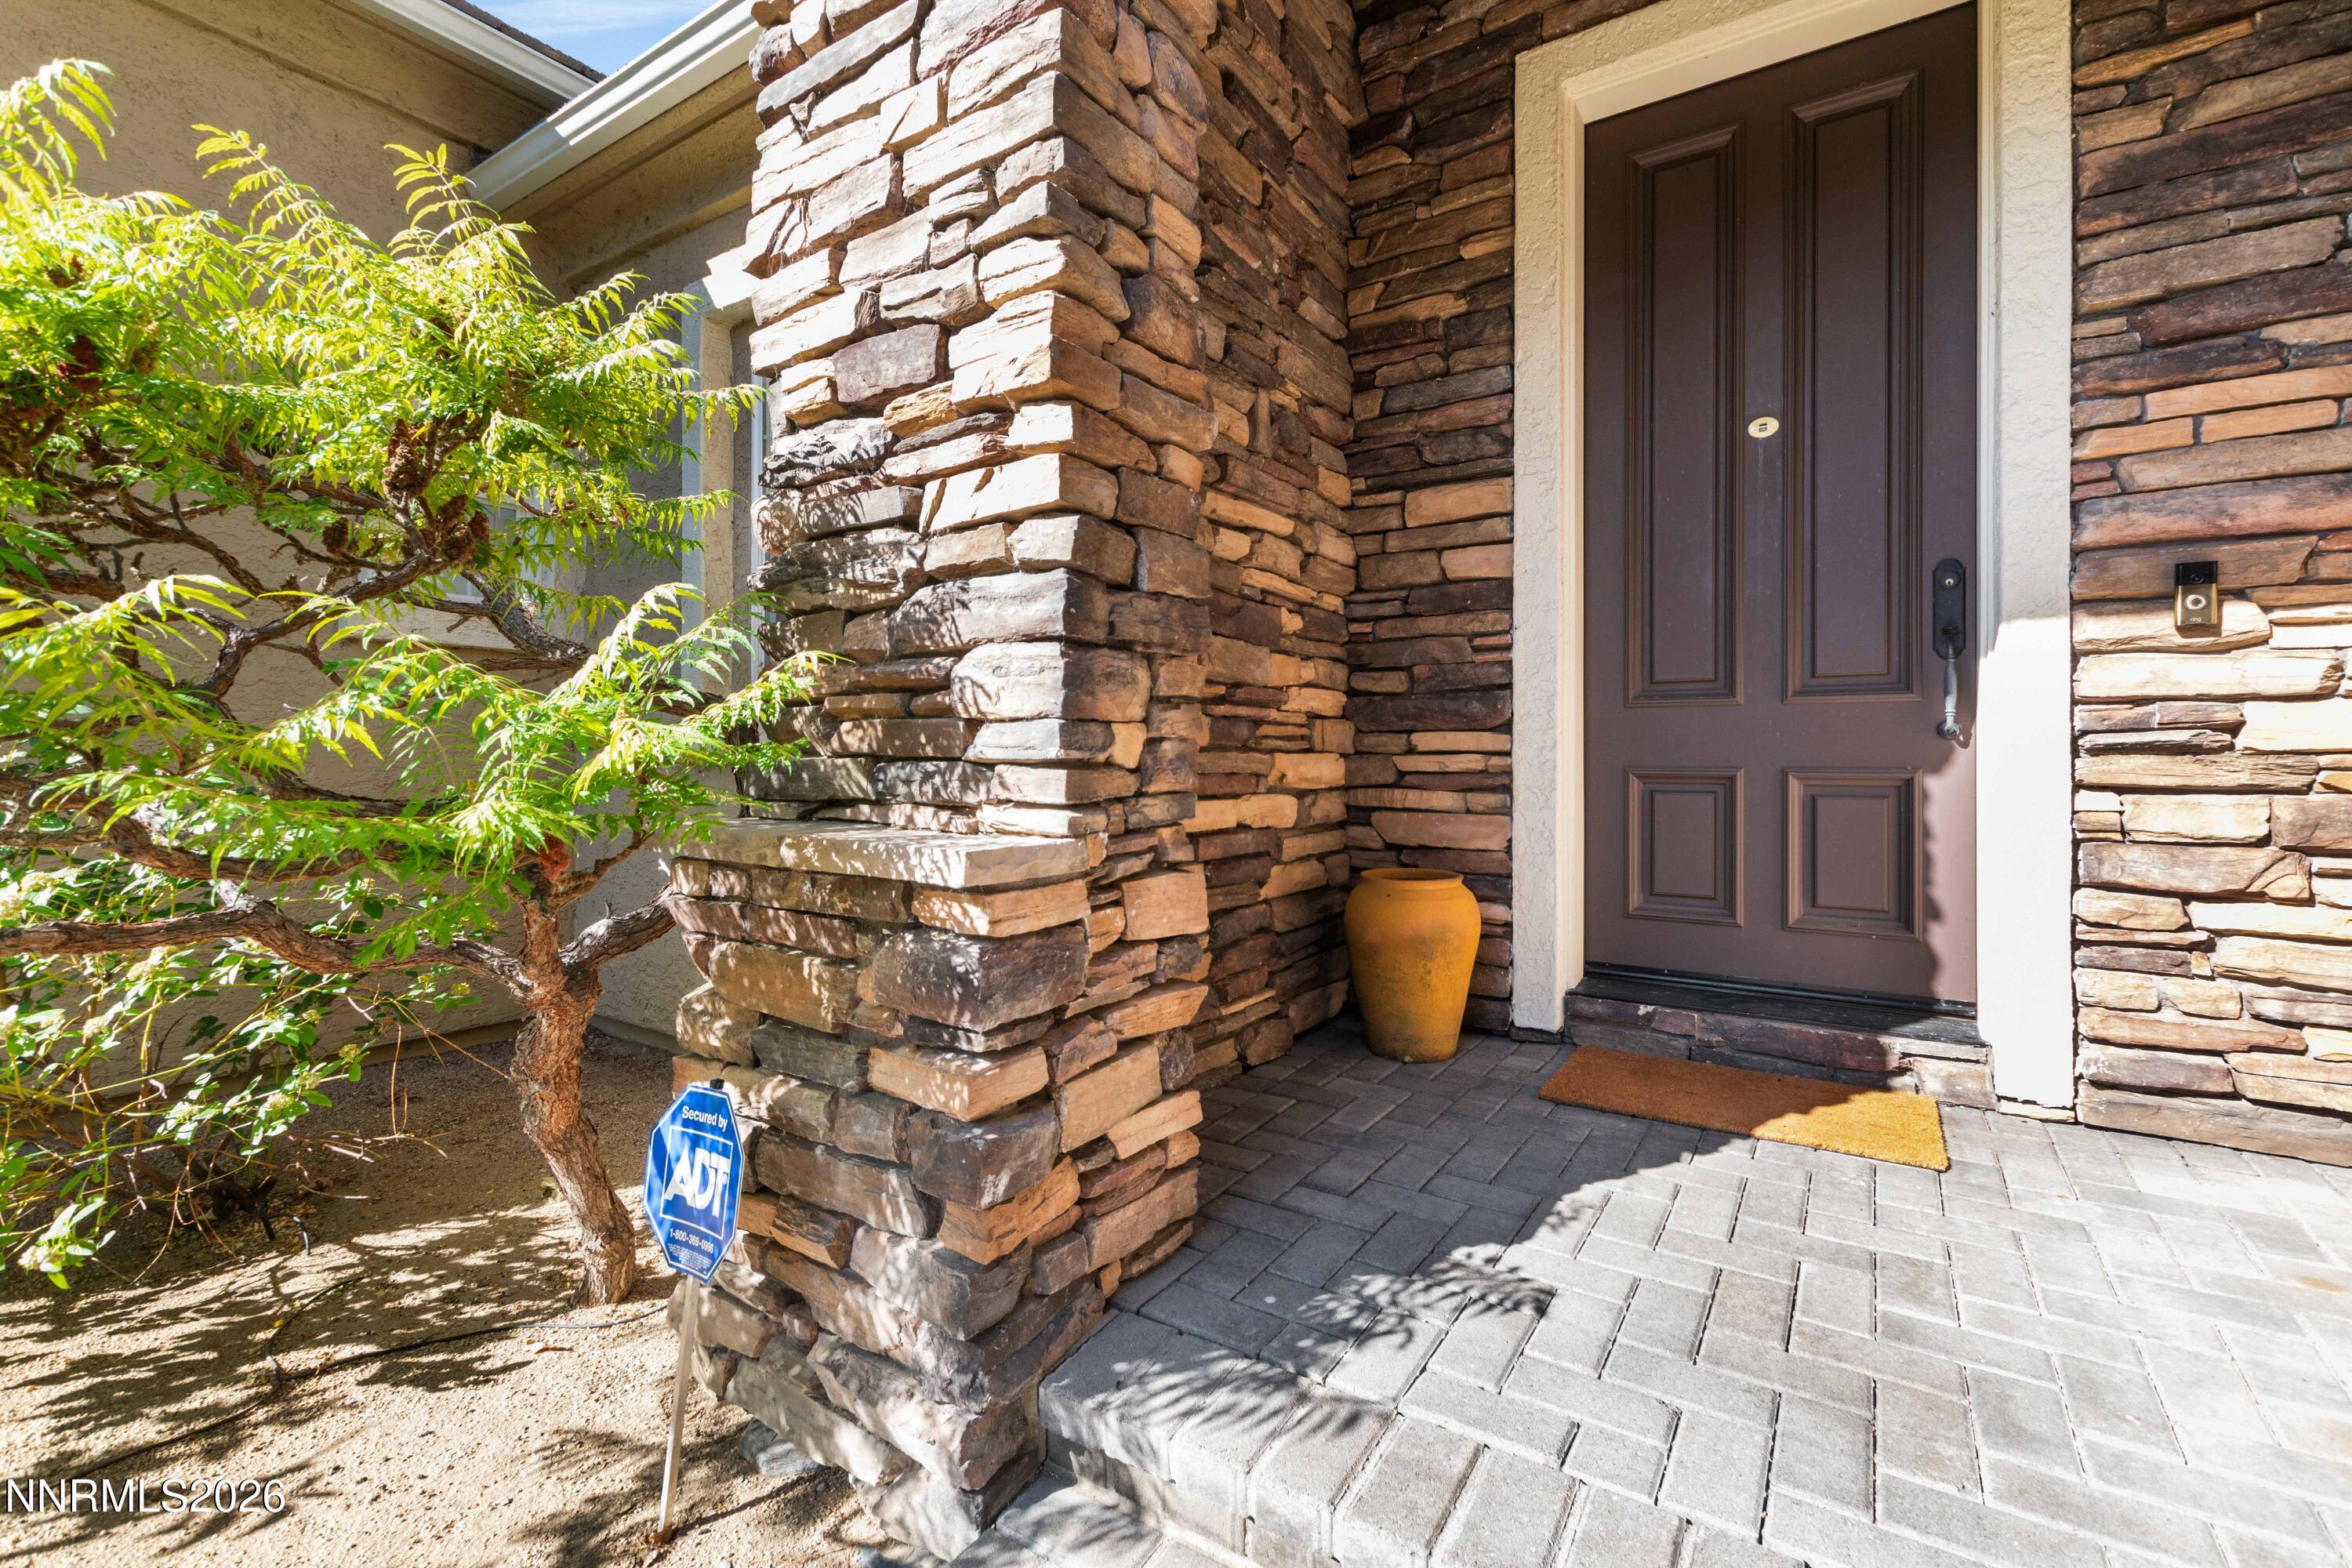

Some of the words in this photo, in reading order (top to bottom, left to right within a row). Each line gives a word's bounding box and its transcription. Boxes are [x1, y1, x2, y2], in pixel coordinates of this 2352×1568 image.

[682, 1105, 717, 1125] Secured
[718, 1114, 728, 1132] by
[664, 1145, 731, 1217] ADT
